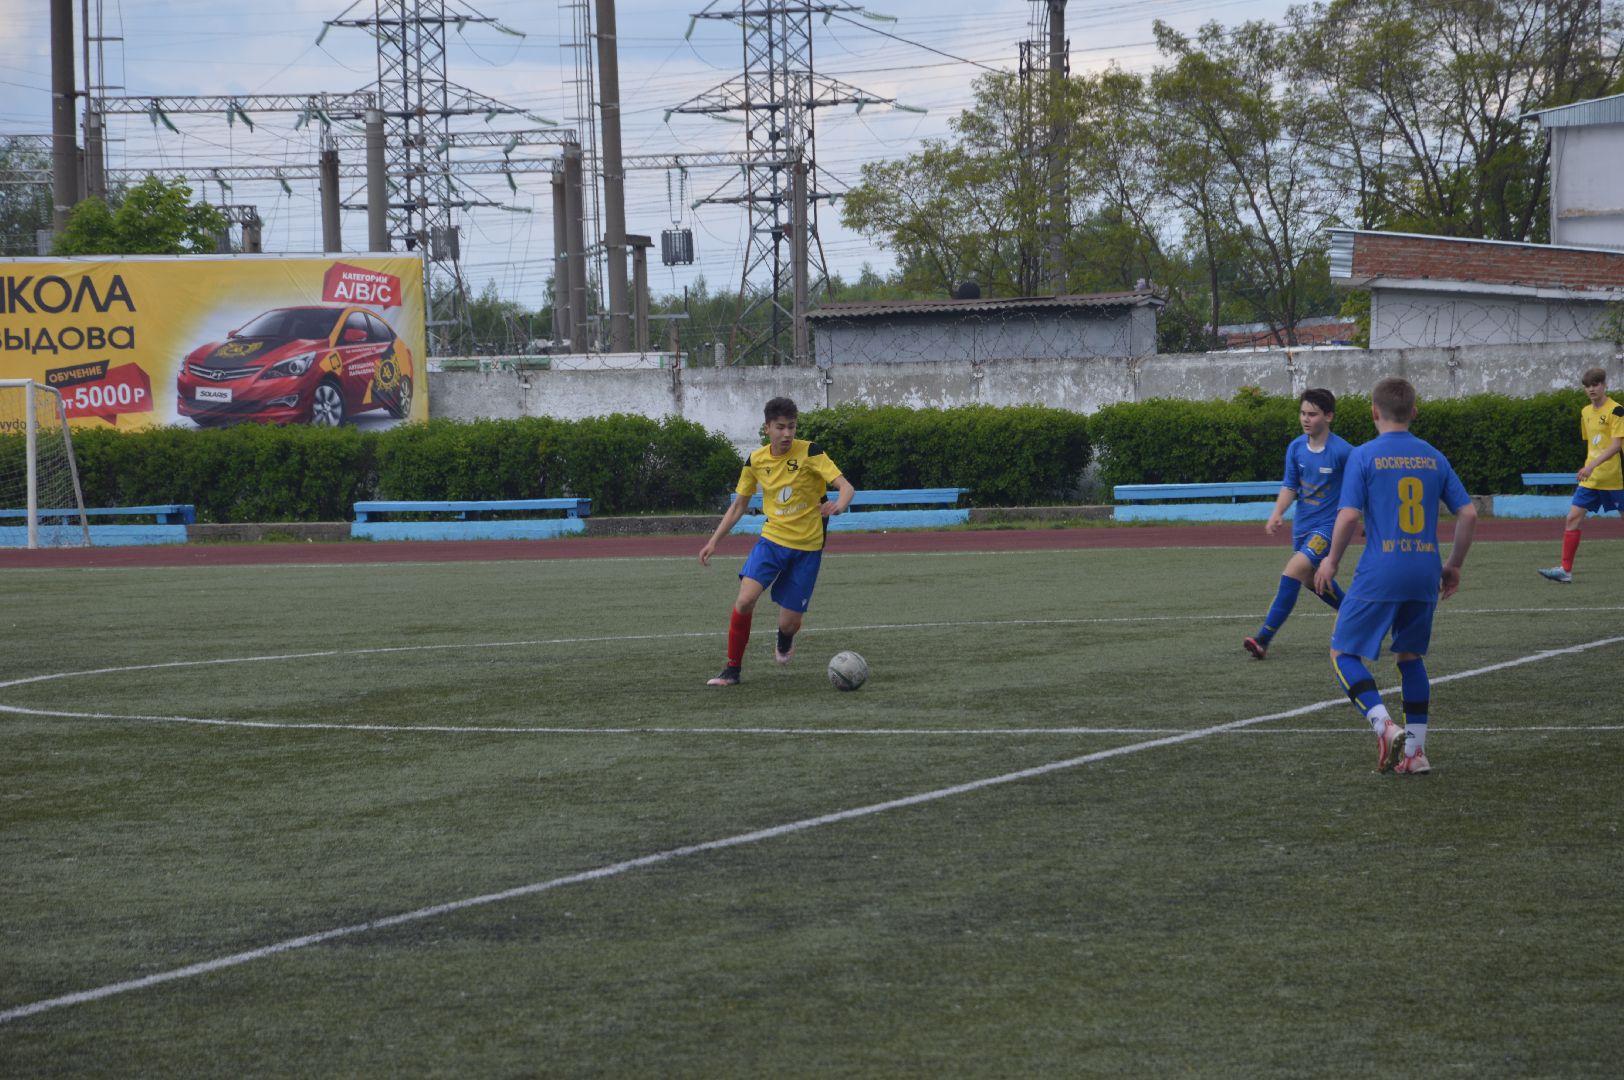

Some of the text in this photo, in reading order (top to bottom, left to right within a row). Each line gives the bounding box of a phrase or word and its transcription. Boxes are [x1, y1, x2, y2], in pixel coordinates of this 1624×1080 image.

[342, 272, 388, 283] КАТЕГОРИИ
[49, 365, 103, 383] ОБУЧЕНИЕ
[75, 383, 131, 409] 5000
[200, 390, 228, 399] SOLARIS
[1375, 456, 1437, 470] ВОСКРЕСЕНСК
[1398, 476, 1425, 534] 8
